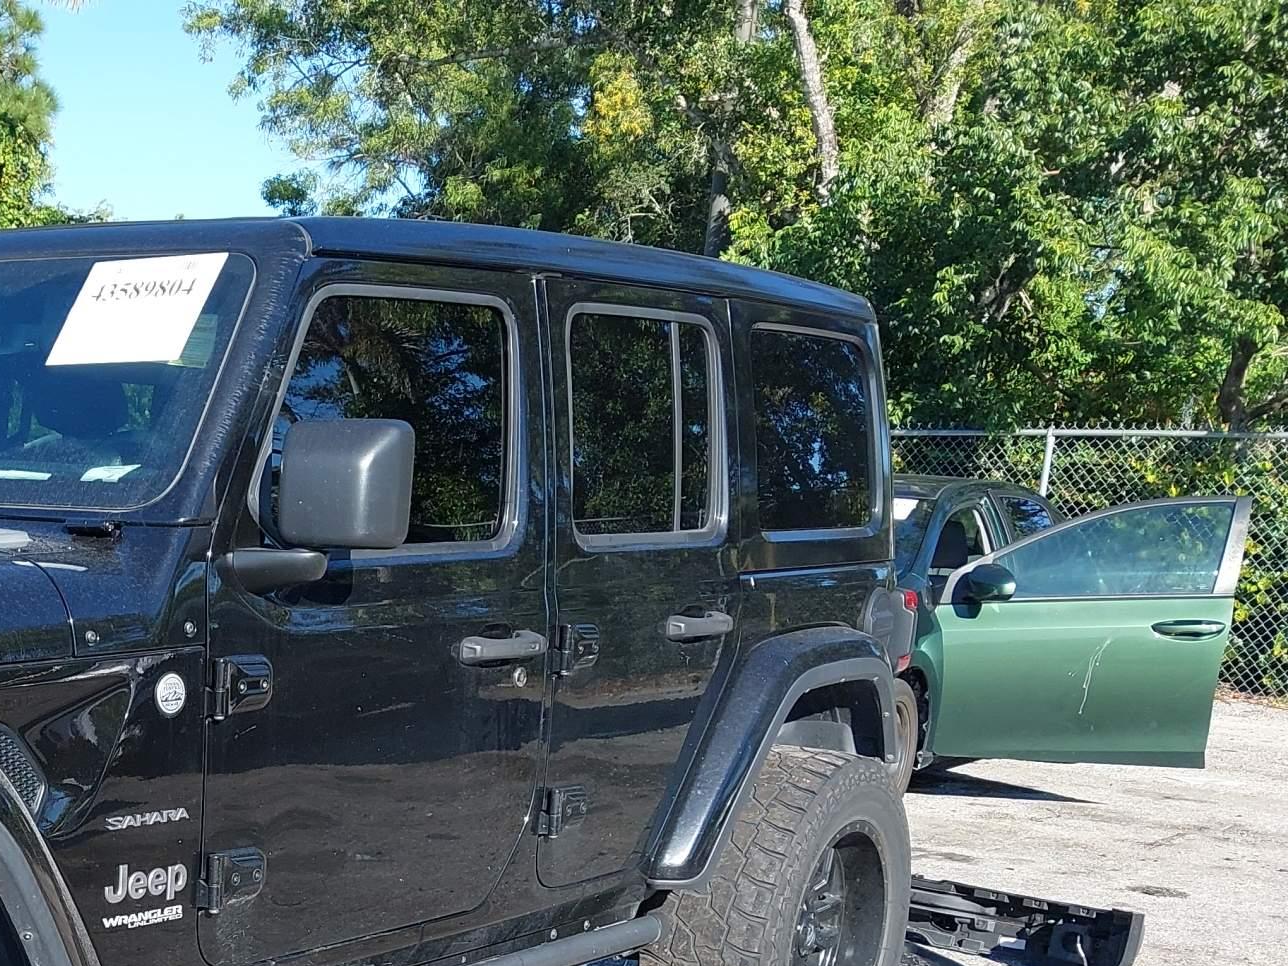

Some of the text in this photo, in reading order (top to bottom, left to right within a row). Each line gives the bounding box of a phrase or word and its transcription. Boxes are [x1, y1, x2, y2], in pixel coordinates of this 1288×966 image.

[92, 278, 197, 302] 43589804
[104, 807, 189, 830] SAHARA
[104, 863, 187, 904] Jeep
[102, 905, 183, 928] WRANGLER
[127, 914, 183, 929] UNLIMITED
